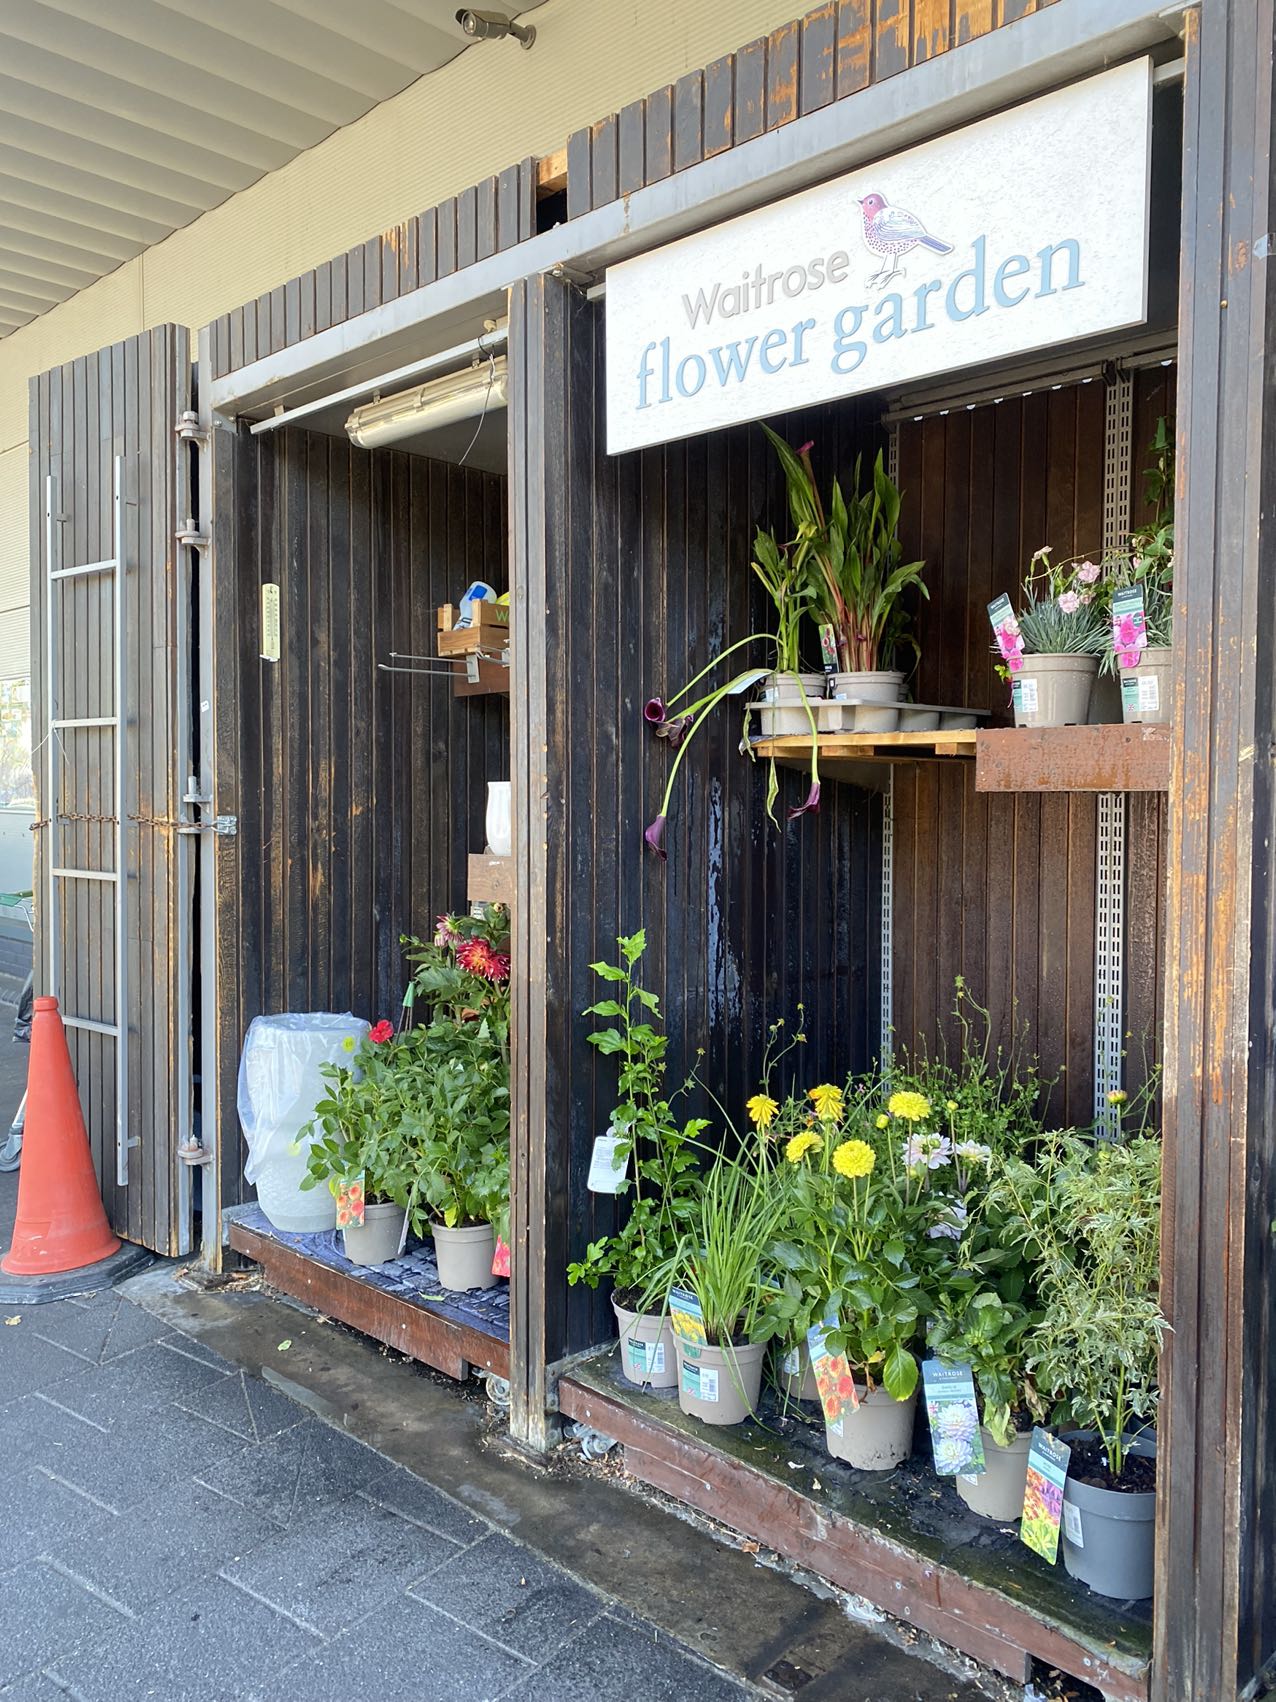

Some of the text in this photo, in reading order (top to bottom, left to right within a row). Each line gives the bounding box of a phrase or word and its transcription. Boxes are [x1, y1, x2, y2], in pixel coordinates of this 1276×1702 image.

[635, 234, 1086, 411] flower garden
[682, 250, 850, 330] Waitrose
[1038, 1442, 1062, 1462] WAITROSE
